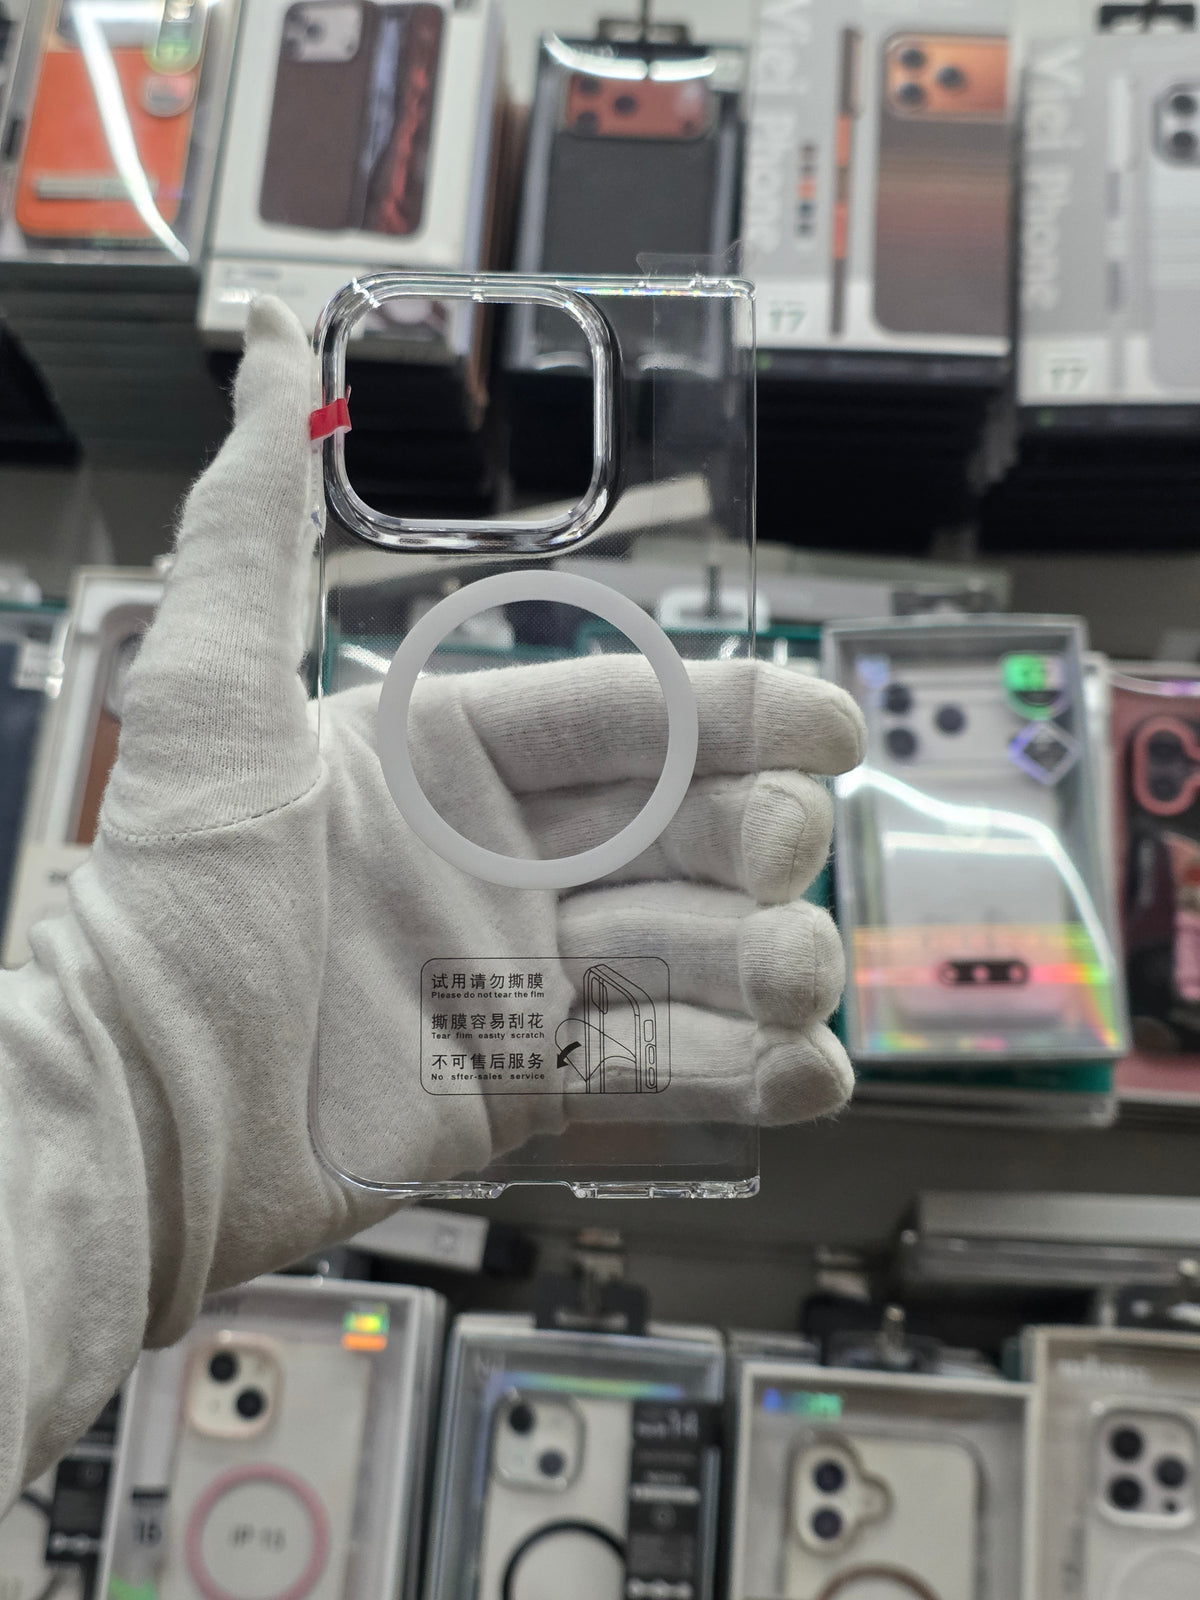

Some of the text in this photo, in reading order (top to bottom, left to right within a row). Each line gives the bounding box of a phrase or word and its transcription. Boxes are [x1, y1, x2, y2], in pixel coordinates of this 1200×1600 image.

[431, 972, 544, 989] 试用请勿撕膜
[431, 991, 461, 999] Please
[464, 991, 475, 999] do
[477, 991, 492, 999] not
[494, 991, 512, 999] tear
[514, 990, 528, 998] the
[431, 1012, 544, 1030] 撕膜容易刮花
[431, 1032, 451, 1040] Tear
[456, 1031, 473, 1039] film
[510, 1031, 545, 1039] scratch
[431, 1052, 544, 1070] 不可售后服务
[431, 1073, 444, 1081] No
[510, 1072, 545, 1080] service
